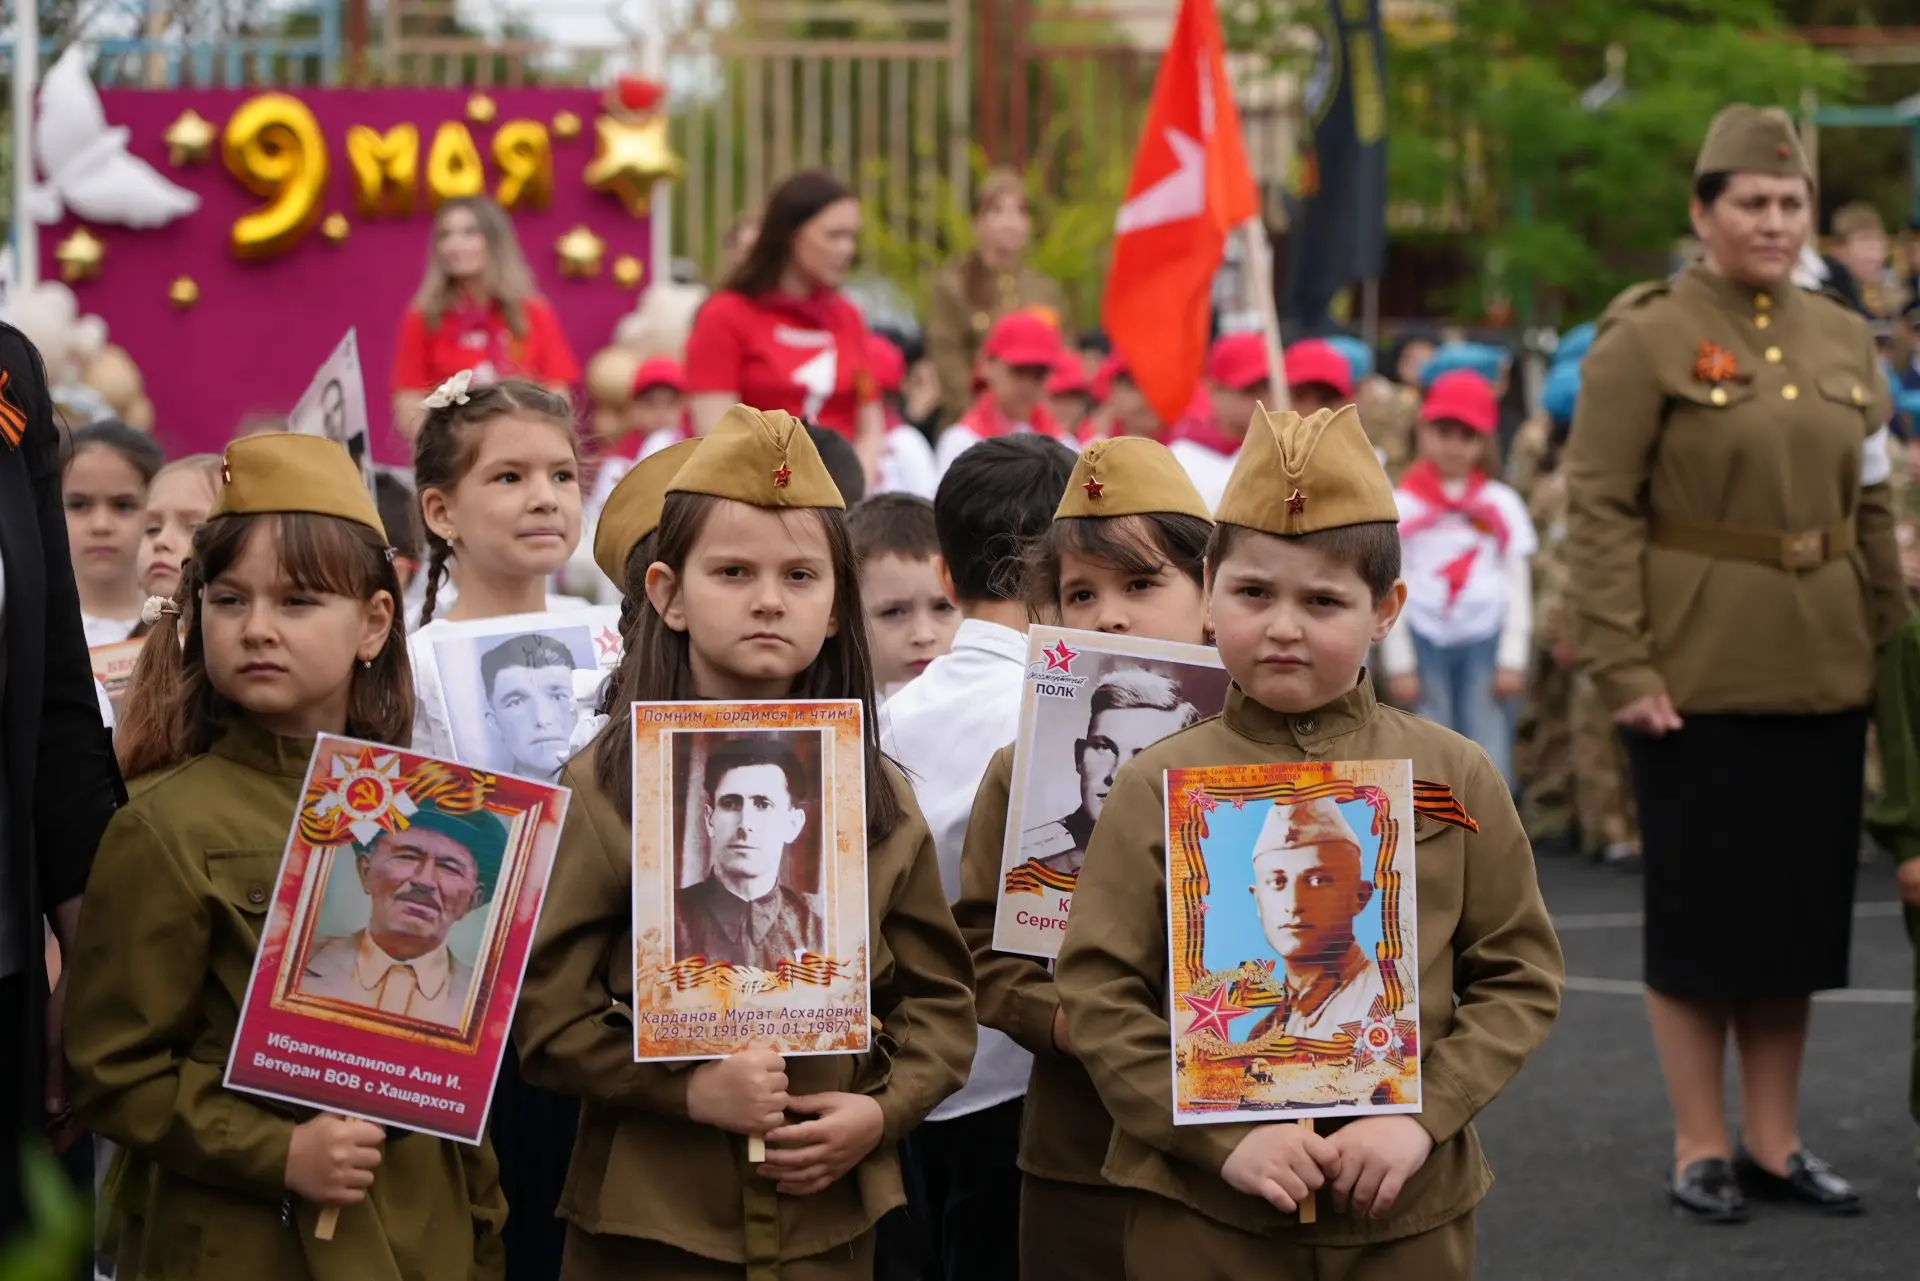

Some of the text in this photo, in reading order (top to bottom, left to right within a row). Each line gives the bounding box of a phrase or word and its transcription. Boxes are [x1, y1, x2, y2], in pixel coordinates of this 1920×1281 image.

[224, 91, 328, 256] 9
[1036, 683, 1076, 697] ПОЛК
[643, 709, 708, 724] Помним,
[715, 710, 788, 724] гордимся
[810, 709, 854, 720] чтим!
[641, 1006, 863, 1025] Карданов Мурат Асхадович
[654, 1020, 851, 1041] (29.12.1916-30.01.1987)
[267, 1032, 462, 1091] Ибрагимхалилов Али И.
[253, 1052, 465, 1114] Ветеран ВОВ с Хашархота
